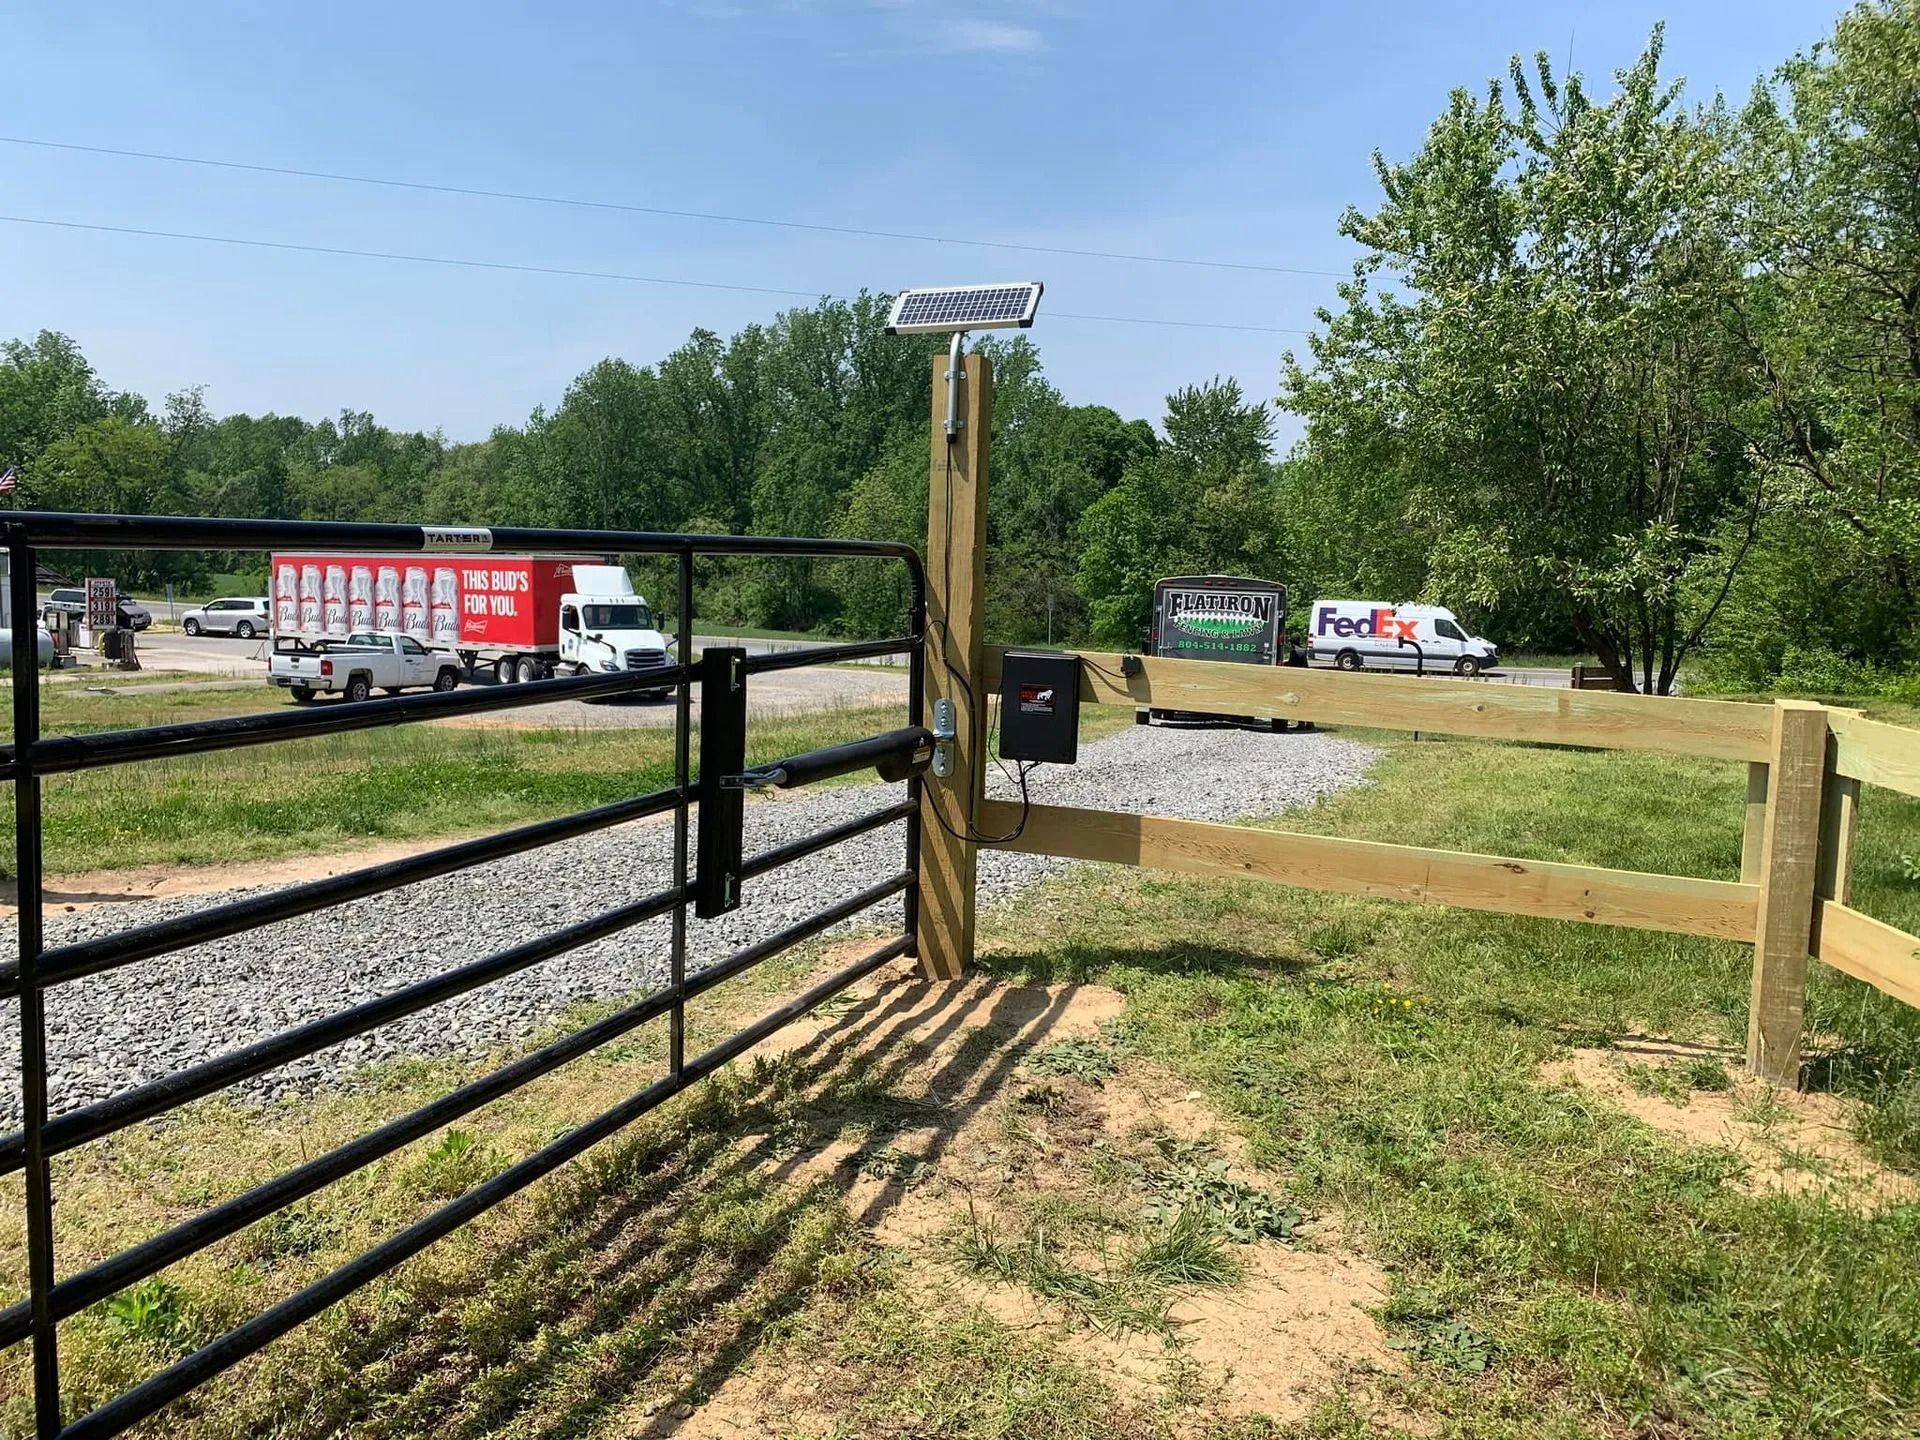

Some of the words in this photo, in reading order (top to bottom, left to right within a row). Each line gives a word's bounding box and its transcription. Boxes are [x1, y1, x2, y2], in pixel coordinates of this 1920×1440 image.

[427, 534, 480, 543] TARTER
[462, 569, 489, 590] THIS
[491, 570, 529, 592] BUD'S
[464, 594, 488, 615] FOR
[489, 595, 518, 616] YOU.
[1168, 592, 1272, 623] FLATIRON
[1173, 619, 1219, 638] FENCING
[1221, 630, 1230, 639] &
[1232, 621, 1265, 638] LAWN
[1318, 607, 1419, 640] FedEx
[1178, 640, 1257, 652] 804-514-1882
